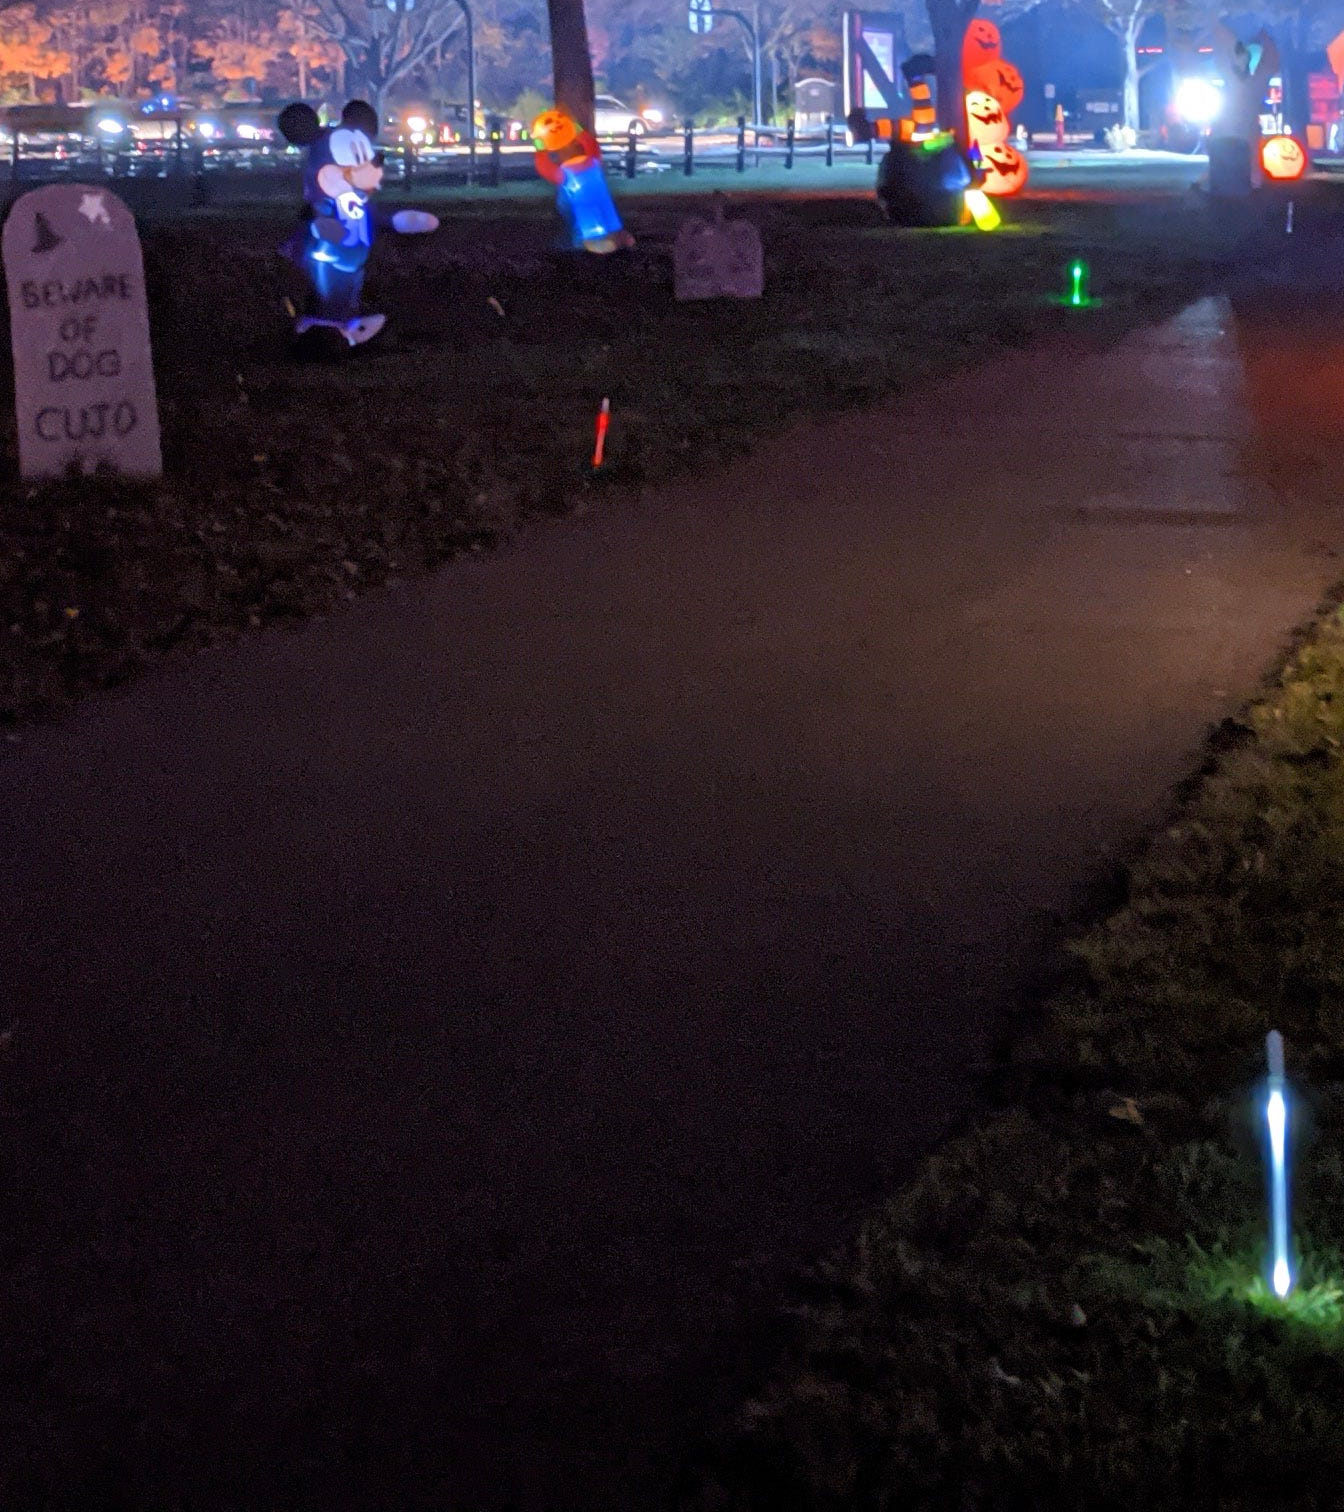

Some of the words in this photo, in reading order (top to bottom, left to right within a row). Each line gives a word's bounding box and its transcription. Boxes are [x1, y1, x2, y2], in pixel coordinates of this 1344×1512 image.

[21, 275, 132, 308] BEWARE
[59, 317, 97, 342] OF
[47, 349, 122, 383] DOG
[35, 401, 137, 441] CUJO
